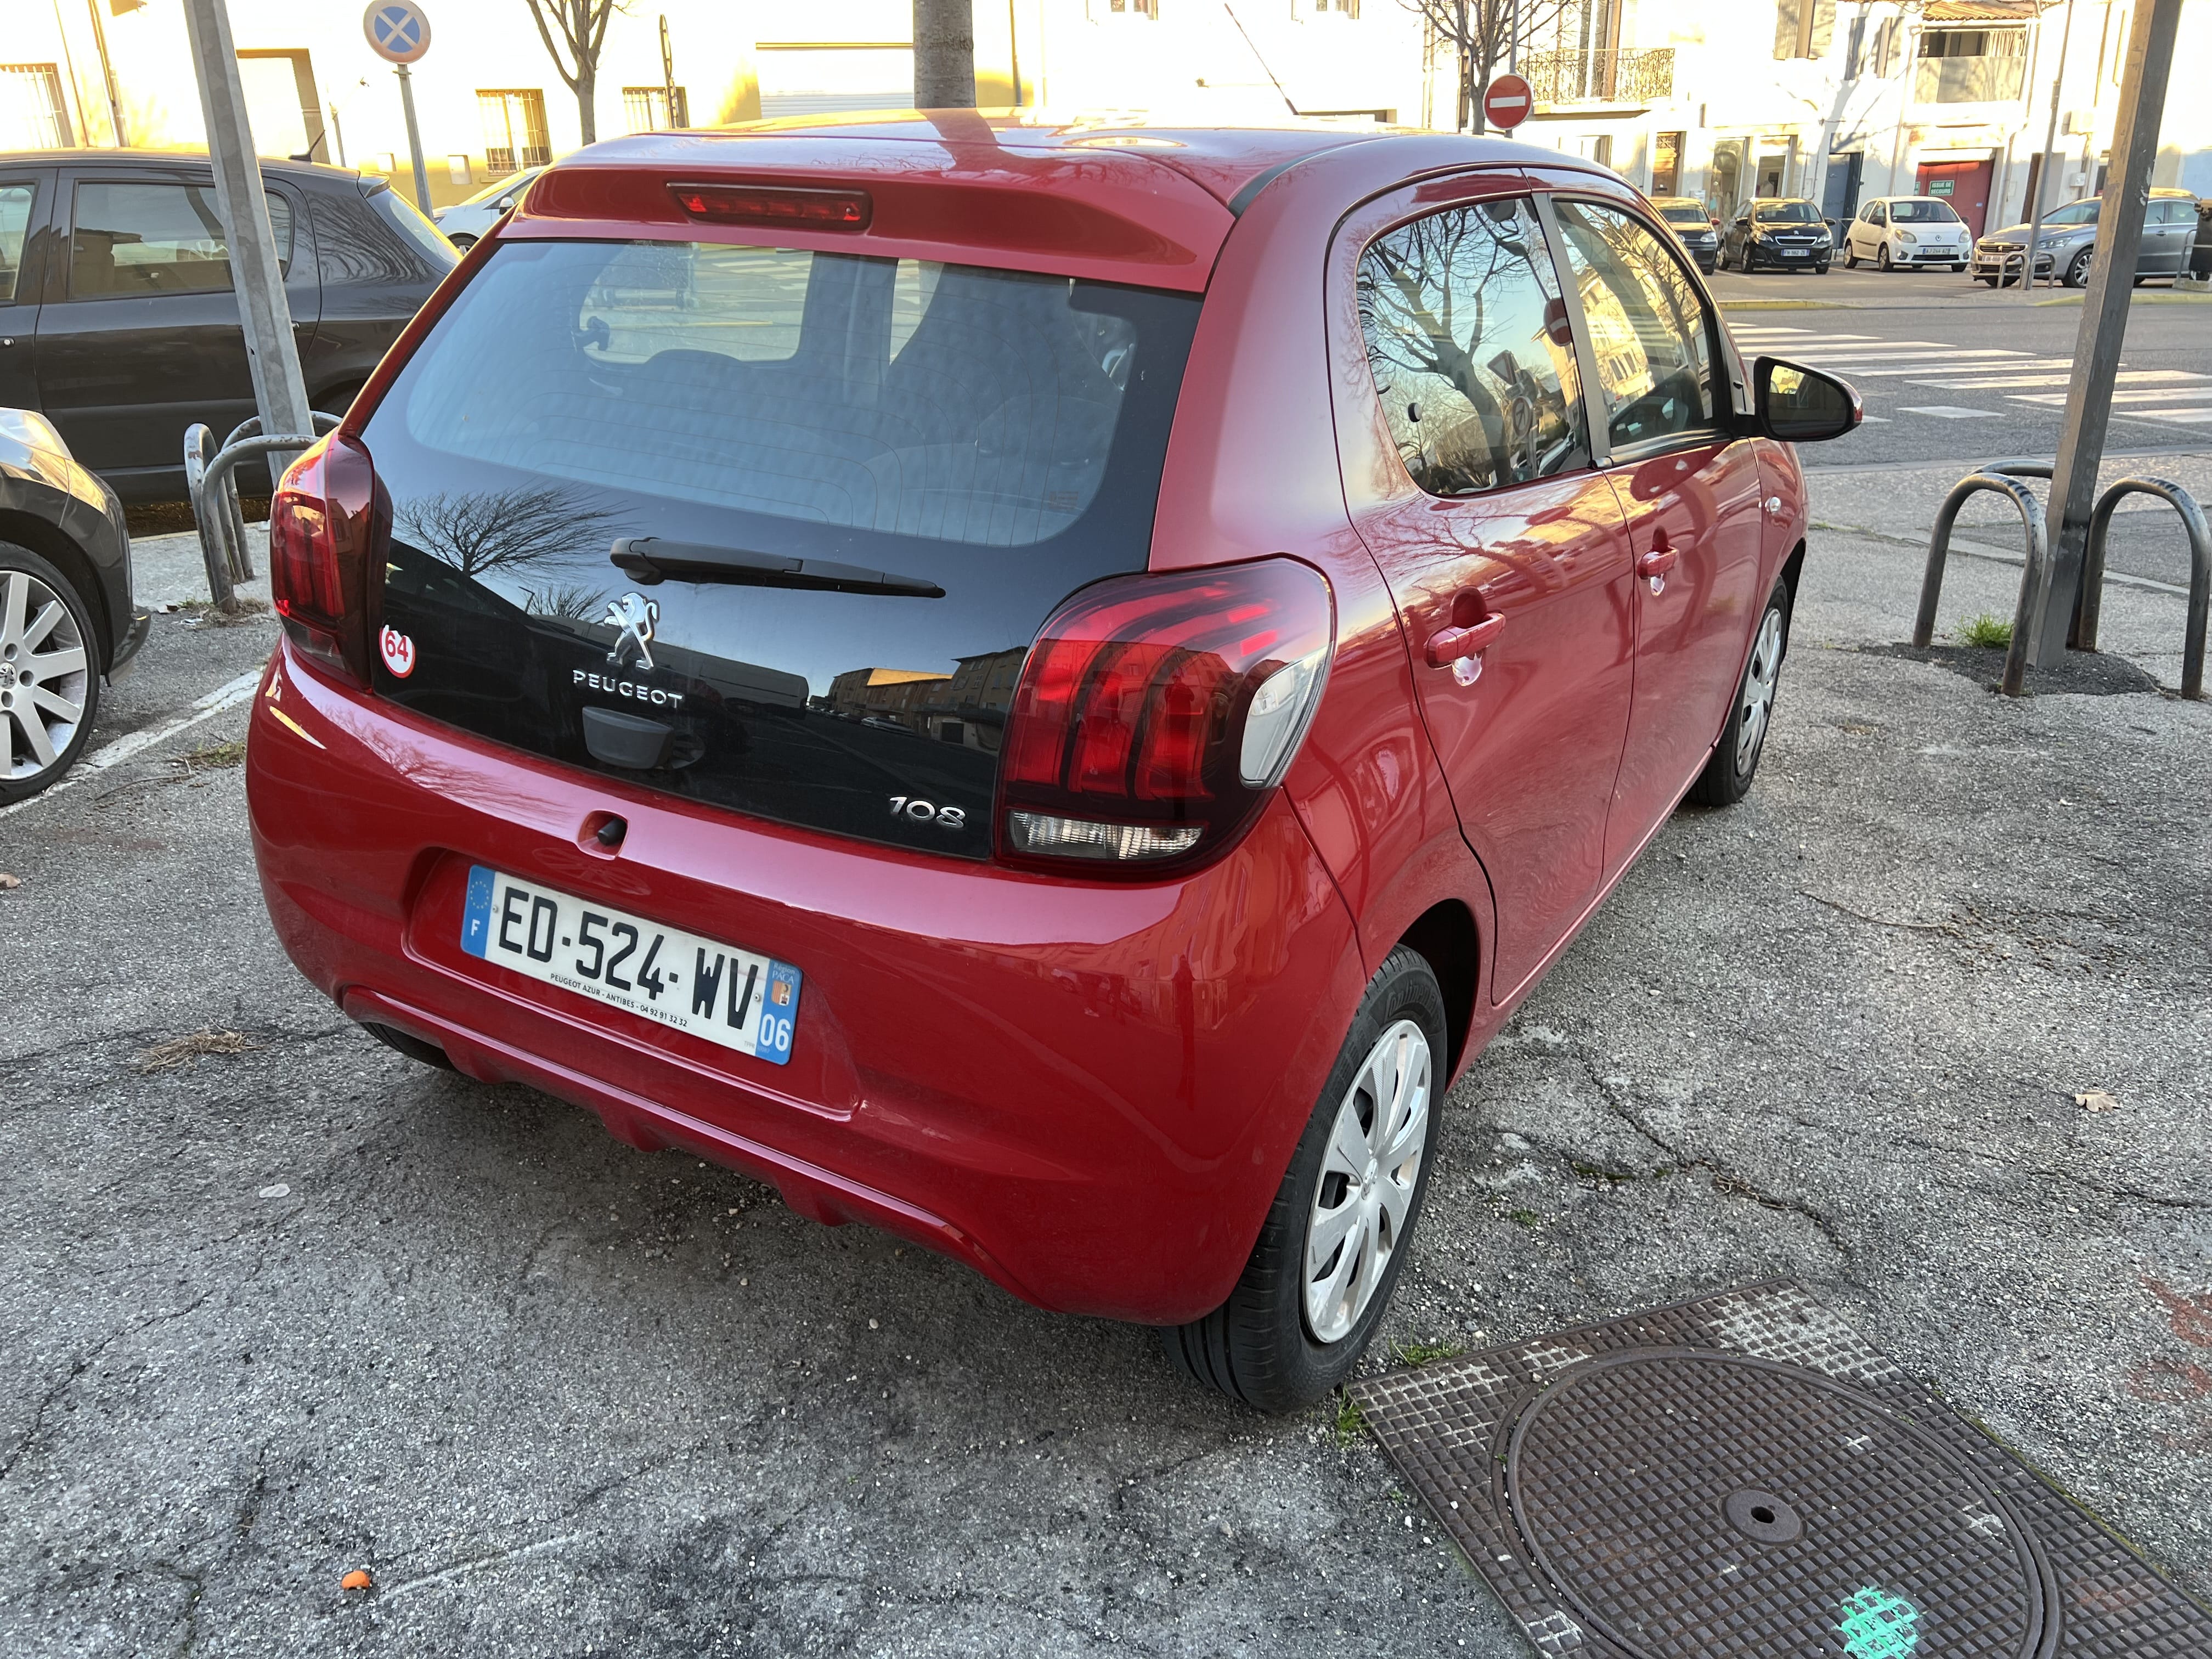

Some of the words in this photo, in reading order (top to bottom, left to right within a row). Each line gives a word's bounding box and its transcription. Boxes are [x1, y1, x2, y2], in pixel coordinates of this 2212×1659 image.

[385, 630, 409, 662] 64
[573, 669, 684, 708] PEUGEOT
[889, 796, 966, 828] 108
[471, 919, 480, 936] F
[499, 887, 758, 1030] ED-524-WV
[774, 962, 795, 975] Région
[772, 969, 794, 985] PACA
[550, 973, 581, 989] PEUGEOT
[582, 985, 601, 997] AZUR
[606, 992, 635, 1008] ANTIBES
[640, 1005, 648, 1013] 04
[650, 1008, 658, 1017] 92
[659, 1012, 667, 1020] 91
[669, 1015, 678, 1023] 32
[679, 1018, 687, 1027] 32
[760, 1013, 791, 1052] 06
